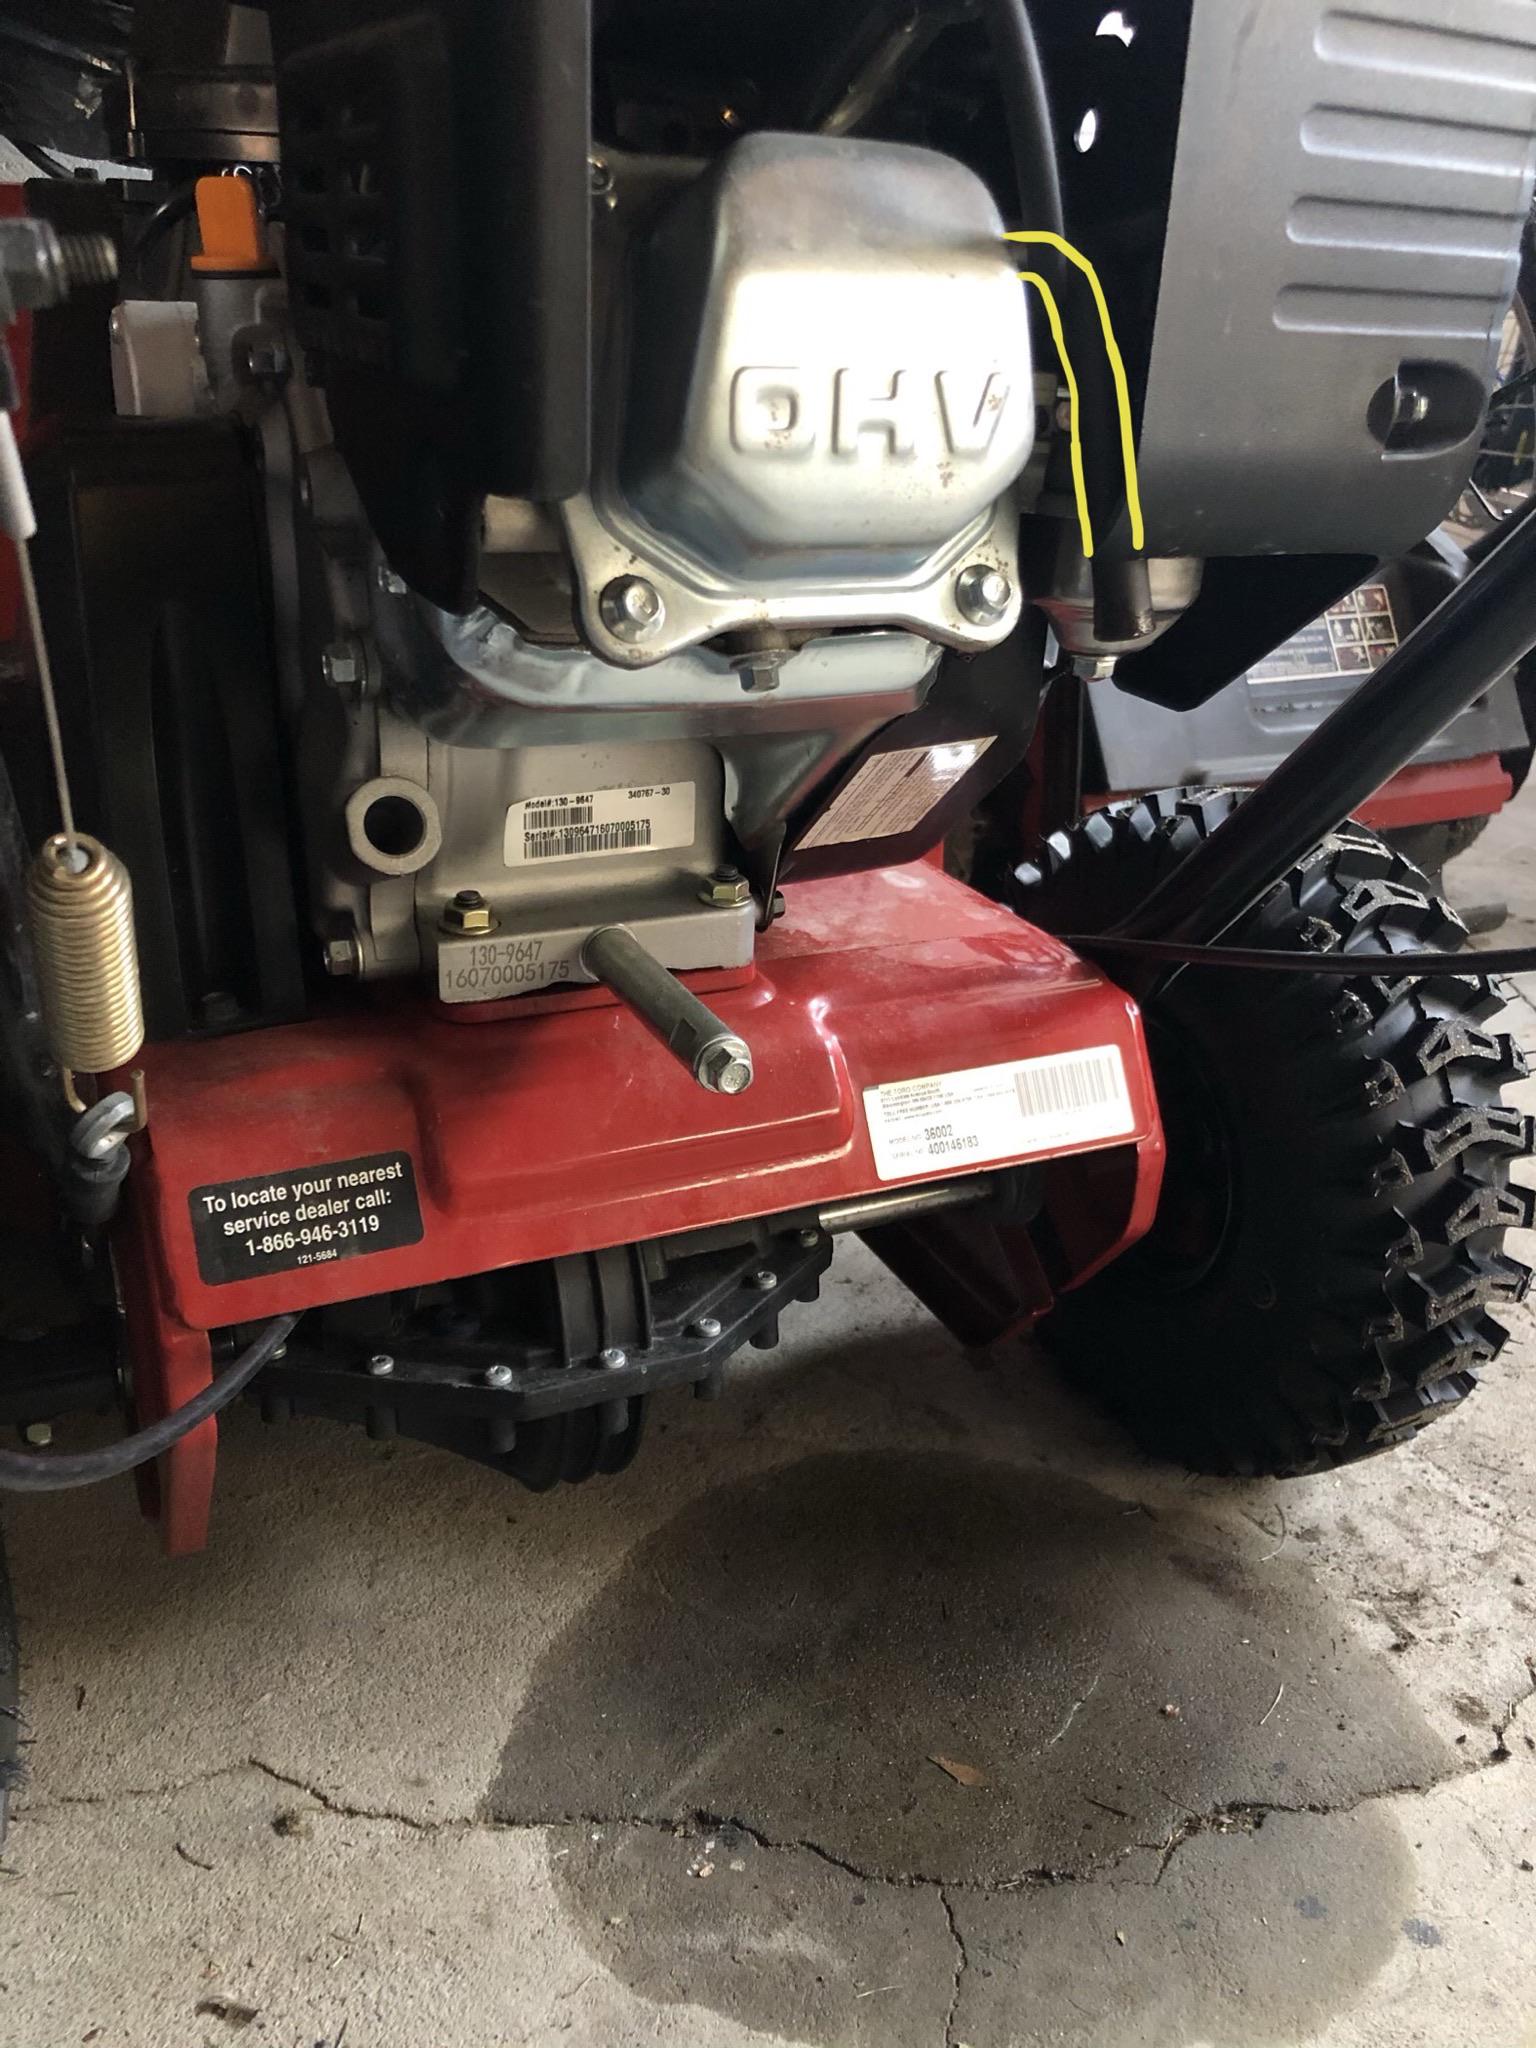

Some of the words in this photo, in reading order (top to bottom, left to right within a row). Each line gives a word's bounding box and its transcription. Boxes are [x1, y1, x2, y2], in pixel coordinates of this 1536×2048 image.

[729, 365, 1011, 464] OHV
[470, 941, 543, 966] 130-9647
[446, 960, 570, 988] 16070005175
[924, 1124, 953, 1141] 36002
[202, 1195, 227, 1214] To
[231, 1187, 287, 1209] locate
[292, 1177, 332, 1201] your
[337, 1162, 403, 1189] nearest
[223, 1211, 290, 1236] service
[295, 1198, 350, 1222] dealer
[355, 1189, 392, 1210] call:
[245, 1214, 380, 1256] 1-866-946-3119
[297, 1248, 338, 1264] 121-5684
